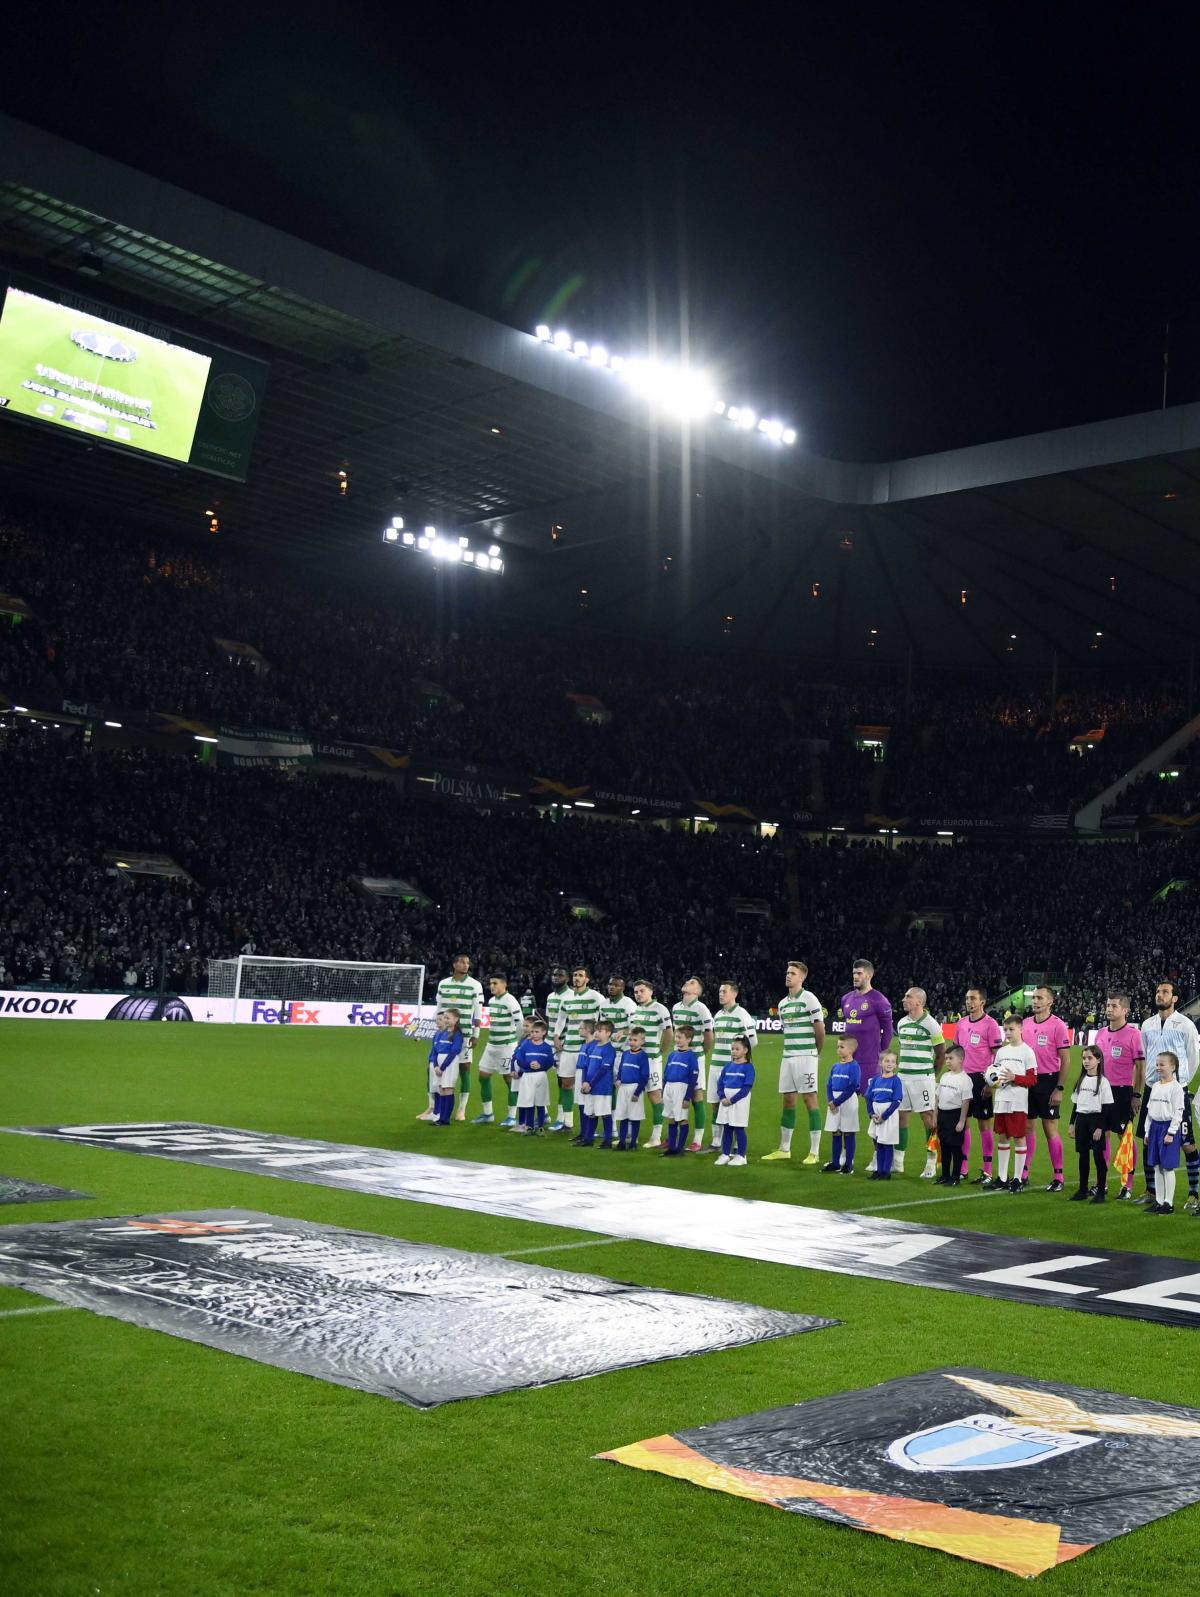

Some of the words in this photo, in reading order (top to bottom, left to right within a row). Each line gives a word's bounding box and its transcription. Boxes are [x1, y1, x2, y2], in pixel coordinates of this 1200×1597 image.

[317, 744, 357, 759] LEAGUE
[431, 771, 483, 799] POLSKA
[594, 791, 617, 802] UEFA
[617, 793, 649, 806] EUROPA
[649, 798, 682, 809] LEAGUE
[920, 818, 942, 827] UEFA
[942, 818, 974, 828] EUROPA
[251, 1000, 320, 1024] FedEx
[351, 1003, 414, 1026] FedEx
[756, 1017, 784, 1031] nte
[803, 1073, 815, 1085] 35
[922, 1090, 930, 1102] 8
[57, 1122, 370, 1167] UEFA
